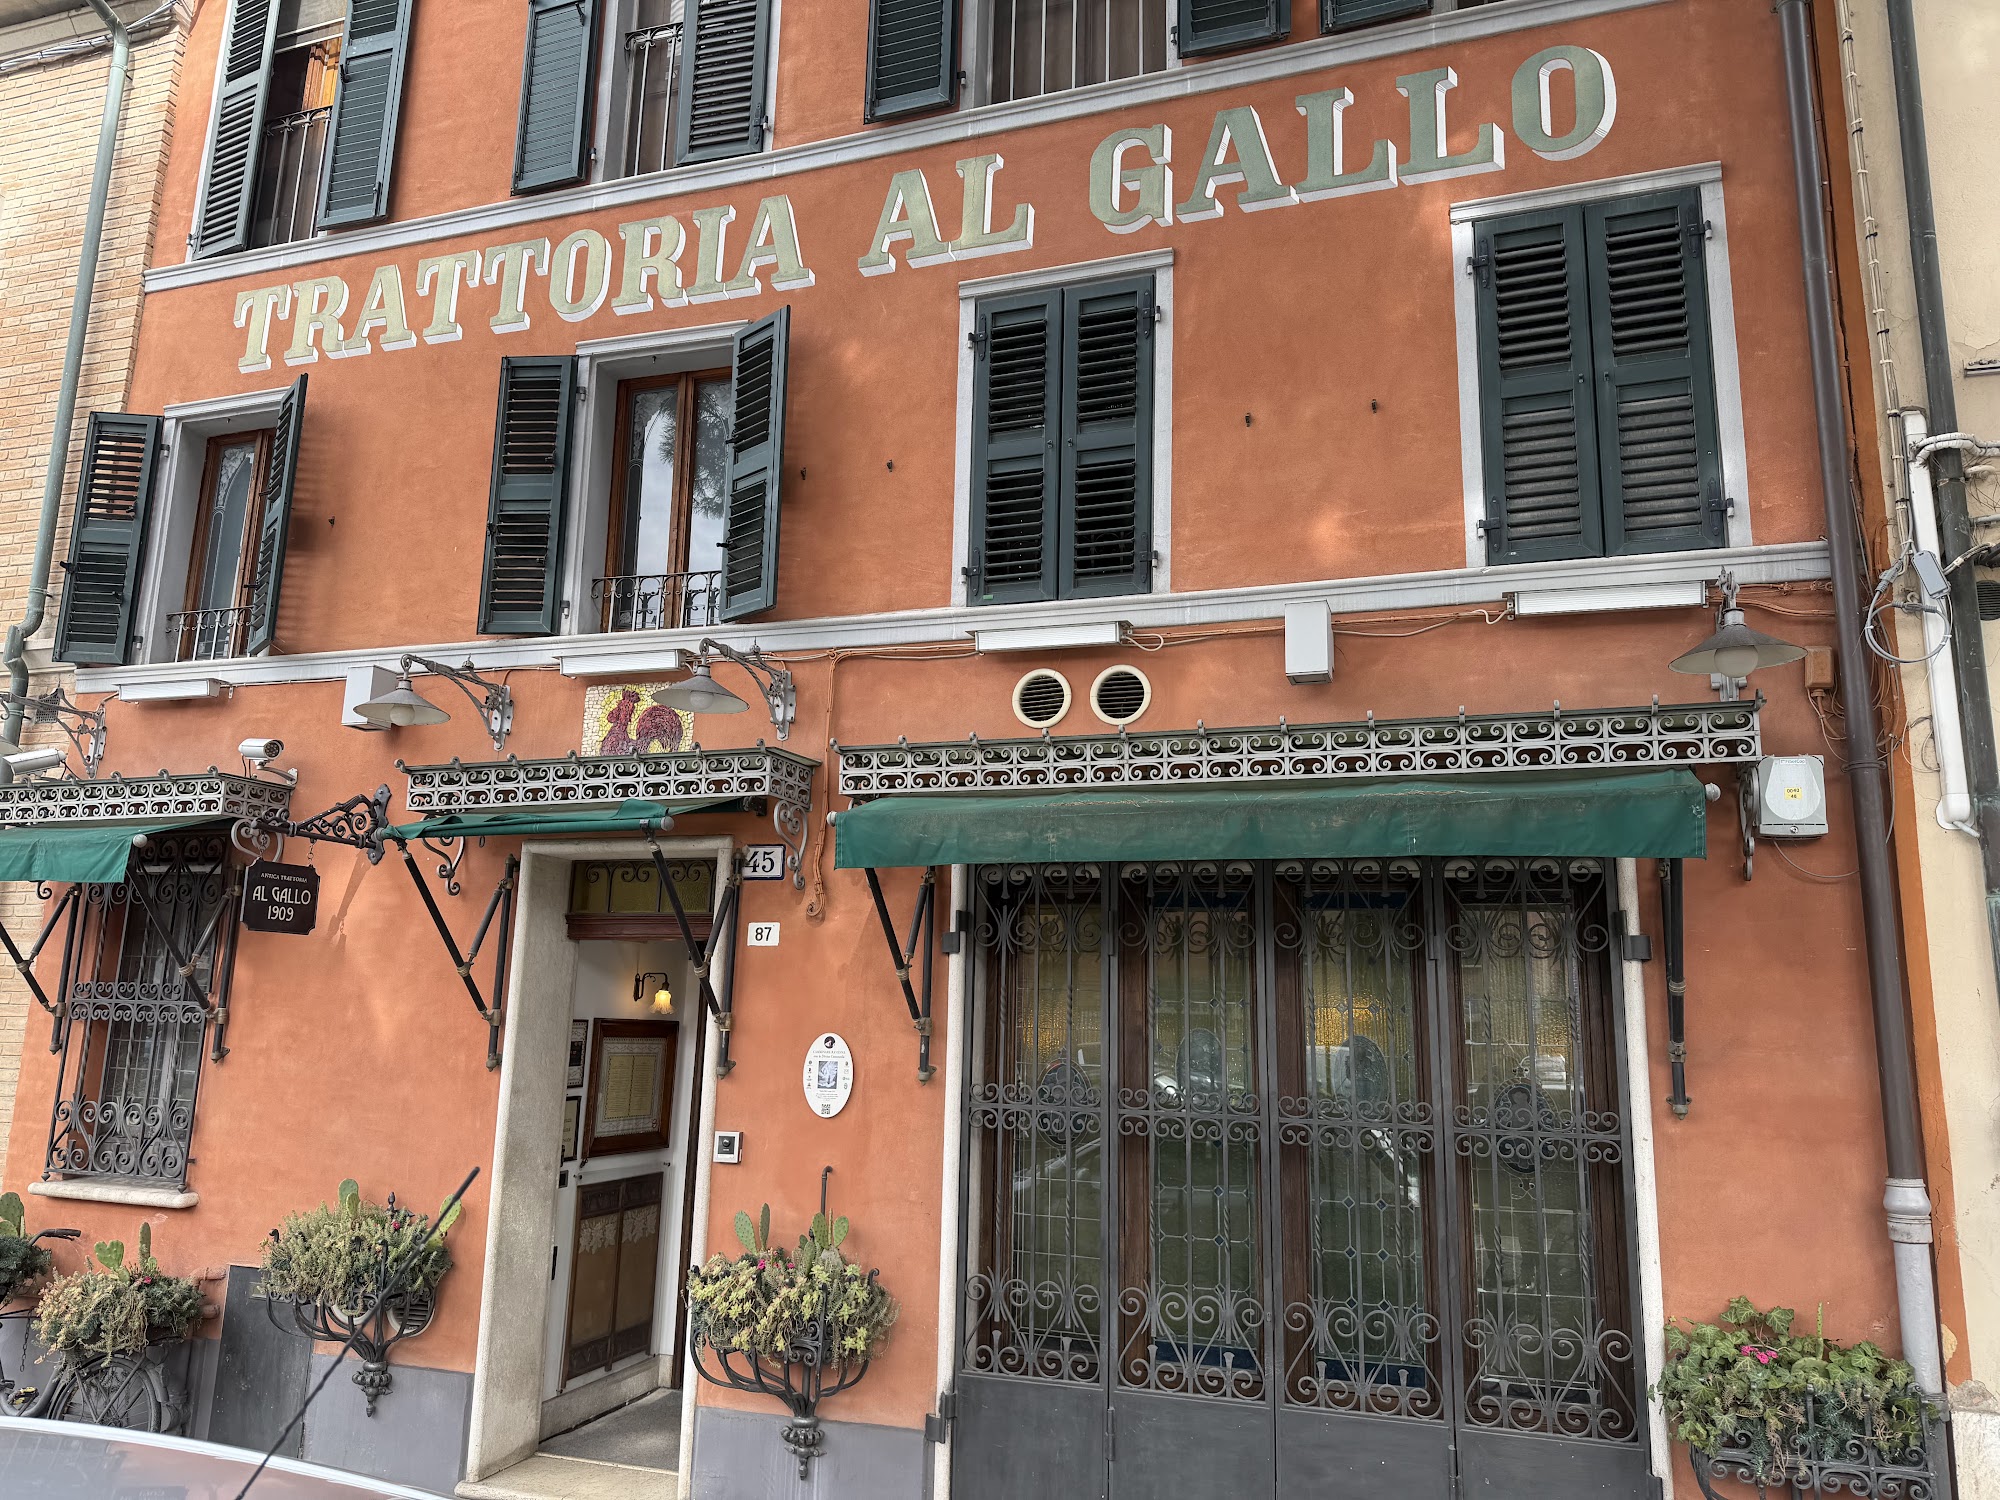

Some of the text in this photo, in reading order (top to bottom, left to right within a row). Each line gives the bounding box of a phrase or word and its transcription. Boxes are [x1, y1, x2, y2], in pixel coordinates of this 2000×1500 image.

[233, 45, 1616, 374] TRATTORIA AL GALLO
[744, 851, 775, 873] 45
[252, 885, 312, 905] AL GALLO
[267, 905, 294, 922] 1909
[754, 926, 772, 942] 87
